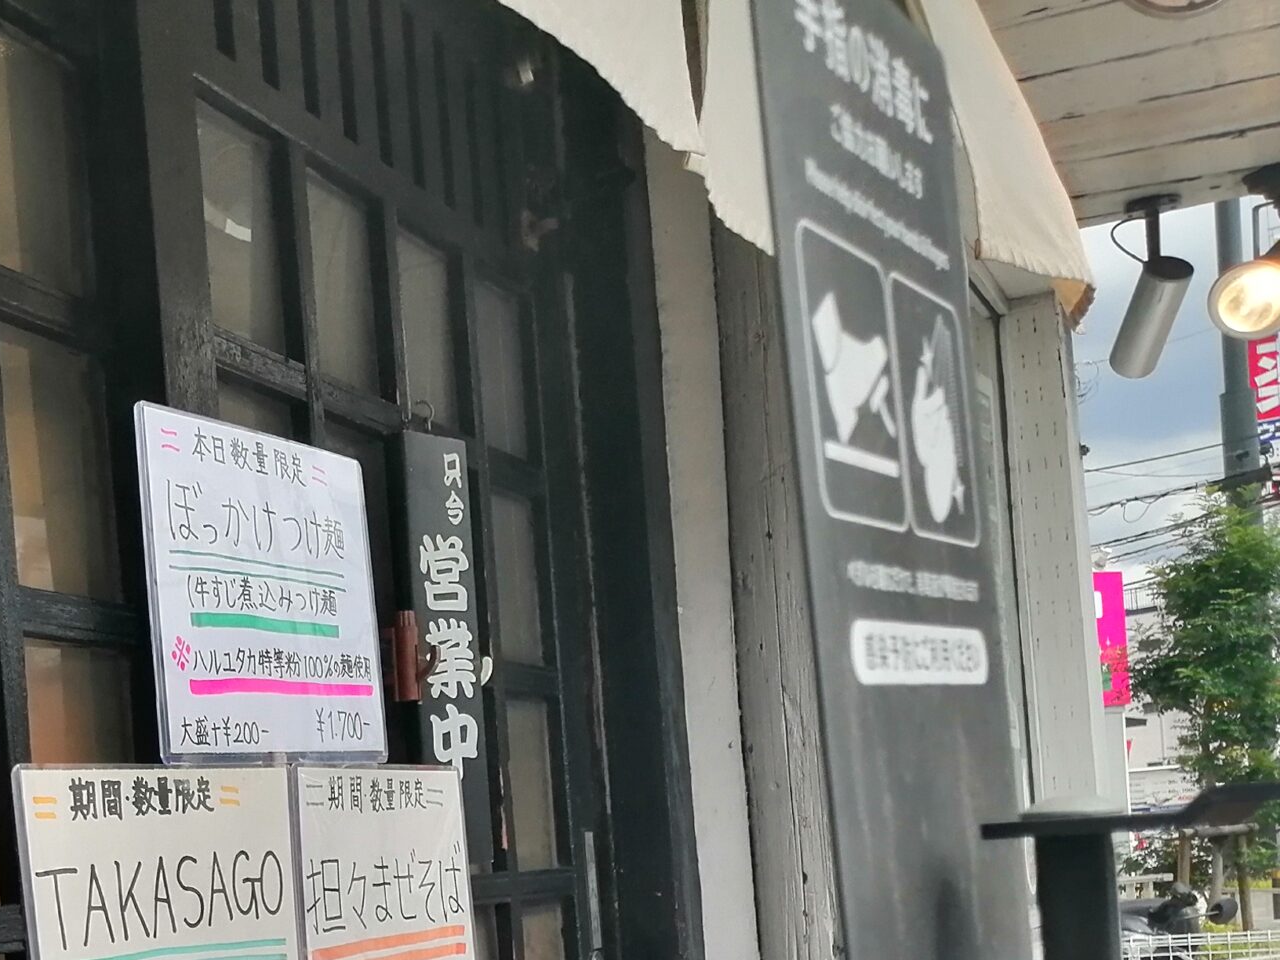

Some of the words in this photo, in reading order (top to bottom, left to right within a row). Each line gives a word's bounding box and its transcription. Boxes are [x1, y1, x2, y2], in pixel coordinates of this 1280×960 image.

[192, 427, 308, 488] 本日数量限定
[166, 480, 345, 560] ぼっかけつけ麺
[35, 850, 283, 951] TAKASAGO
[306, 840, 465, 936] 担々まぜそば
